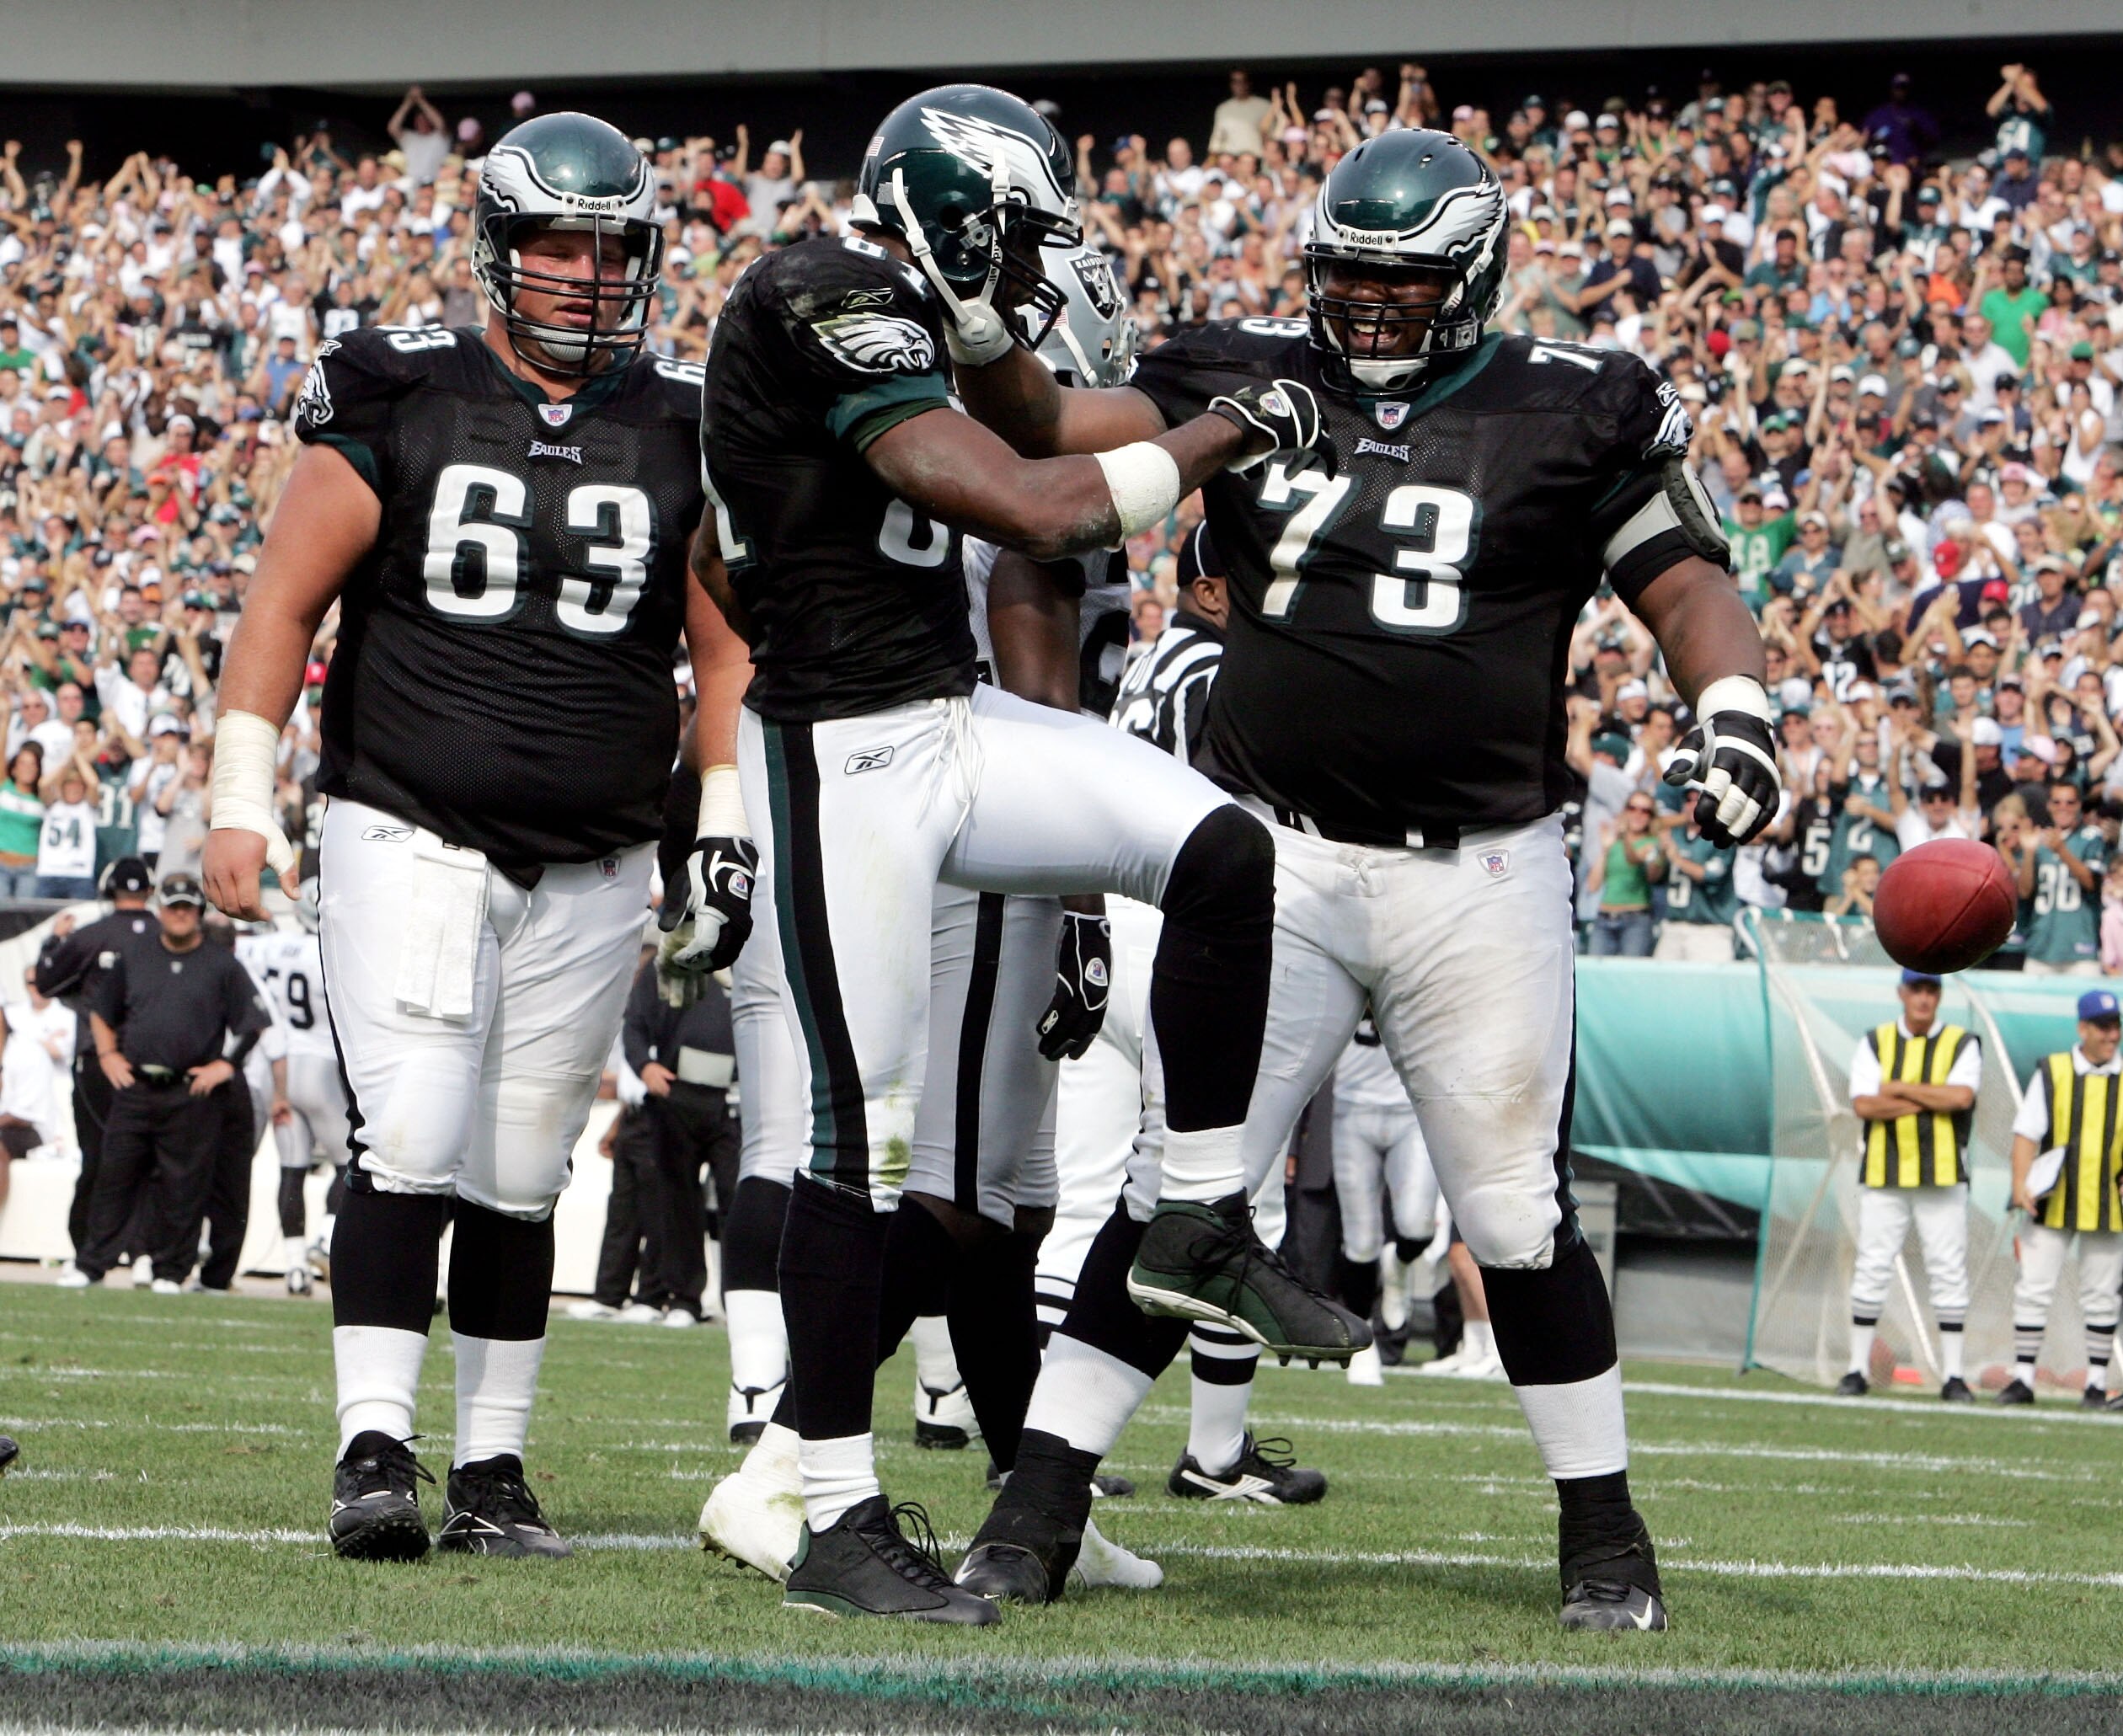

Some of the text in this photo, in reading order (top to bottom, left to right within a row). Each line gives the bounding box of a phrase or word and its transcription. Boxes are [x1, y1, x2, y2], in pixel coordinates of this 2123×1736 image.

[578, 198, 611, 211] Riddell
[1350, 231, 1382, 245] Riddell
[527, 440, 583, 465] EAGLES
[1354, 437, 1412, 462] EAGLES
[423, 464, 651, 633] 63
[1260, 463, 1474, 628] 73
[48, 817, 81, 848] 54
[1802, 825, 1832, 876] 5
[2035, 863, 2082, 916] 36
